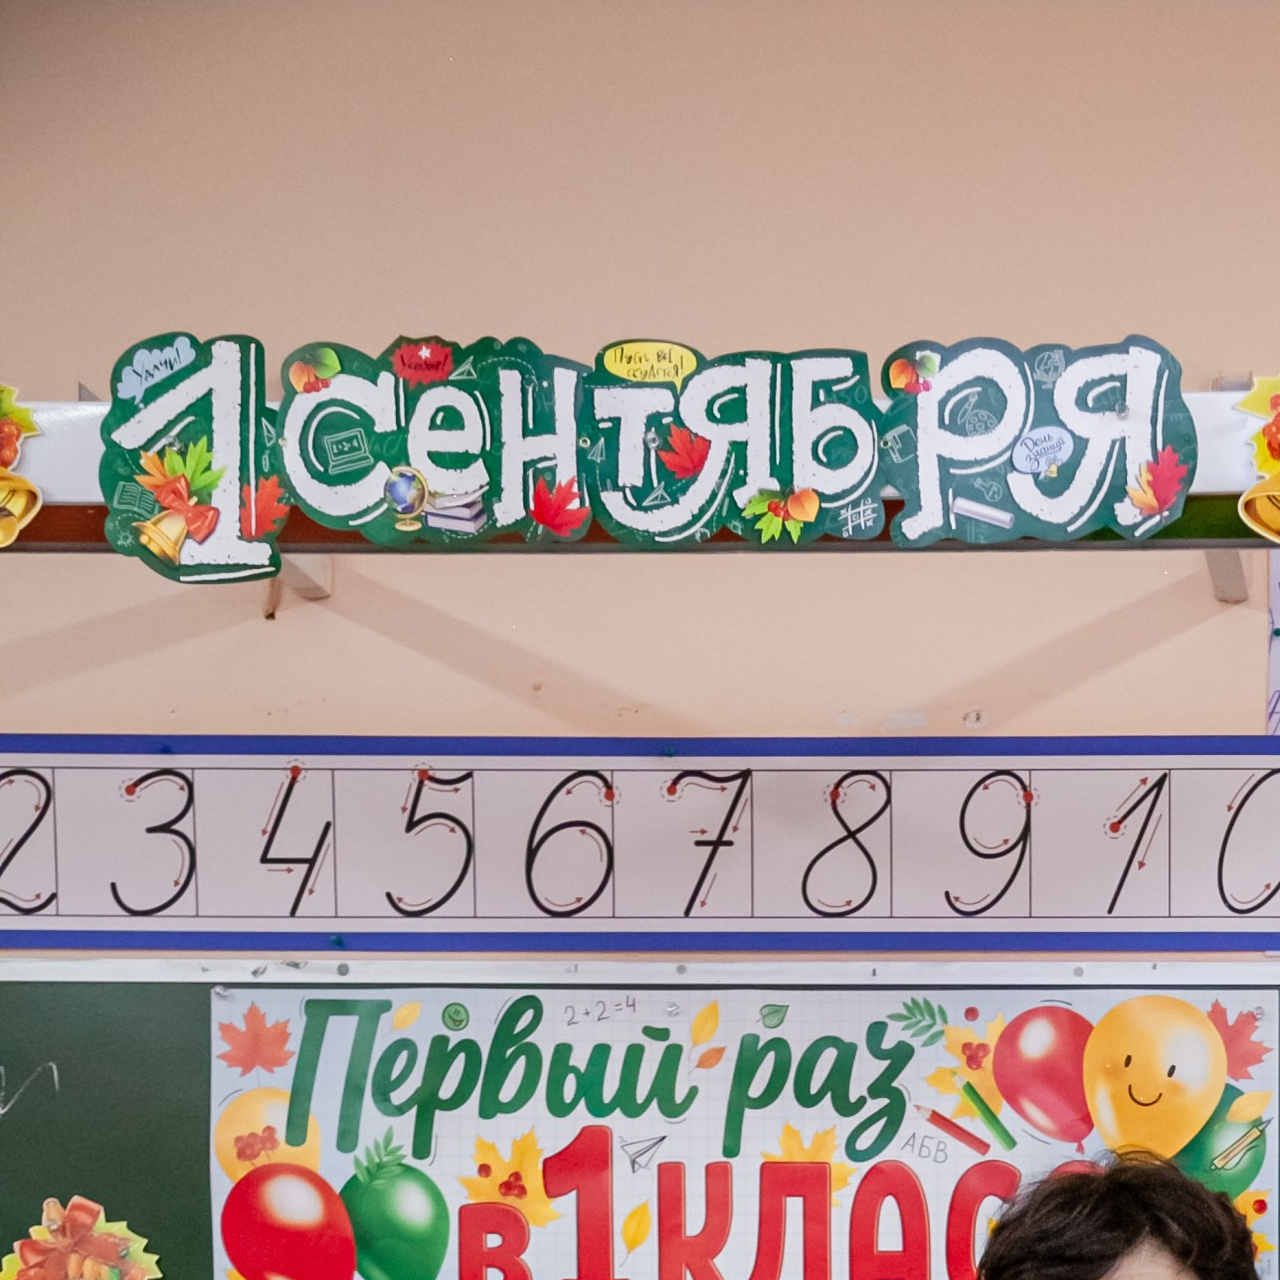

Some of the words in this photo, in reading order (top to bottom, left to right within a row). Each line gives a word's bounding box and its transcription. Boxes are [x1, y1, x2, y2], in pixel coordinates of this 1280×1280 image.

[111, 341, 272, 565] 1
[110, 767, 196, 917] 3
[260, 767, 331, 917] 4
[385, 768, 473, 917] 5
[525, 769, 616, 917] 6
[666, 767, 753, 917] 7
[801, 769, 892, 917] 8
[943, 769, 1031, 916] 9
[1107, 772, 1168, 914] 1
[285, 995, 699, 1160] Первый
[722, 1021, 915, 1162] раз
[901, 1131, 948, 1163] АБВ
